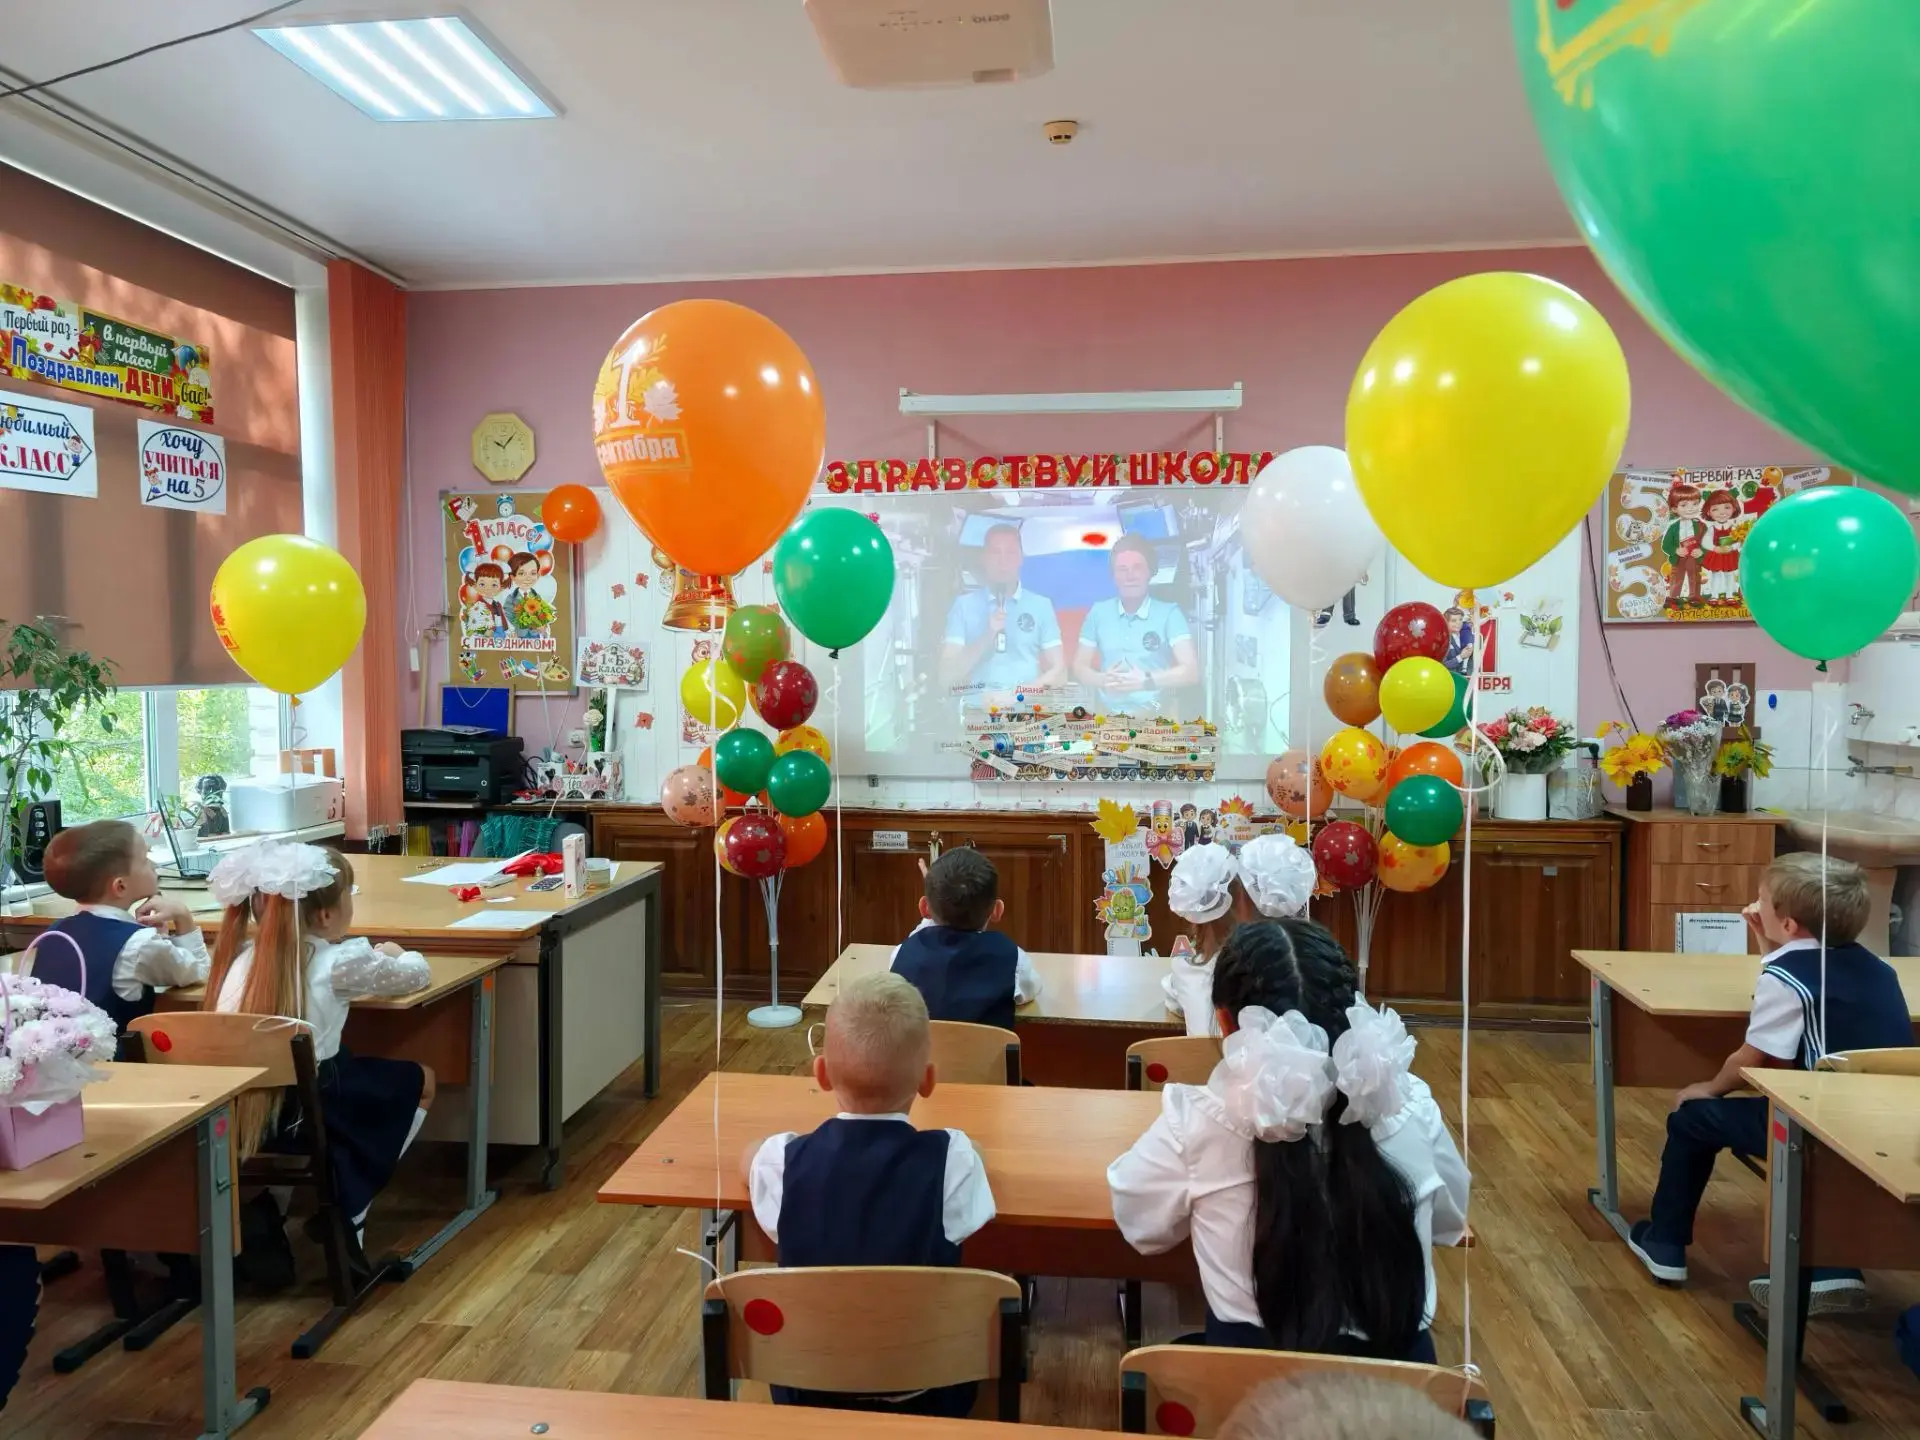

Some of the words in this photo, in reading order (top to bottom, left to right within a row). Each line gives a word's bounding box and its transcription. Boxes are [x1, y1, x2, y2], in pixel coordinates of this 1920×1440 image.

[4, 310, 50, 335] Первый
[52, 322, 71, 340] раз
[102, 324, 115, 340] в
[115, 334, 169, 358] первый
[11, 335, 123, 393] Поздравляем,
[125, 366, 175, 400] ДЕТИ
[114, 349, 158, 371] класс!
[610, 340, 641, 429] 1
[0, 413, 71, 440] юбимый
[144, 449, 220, 480] УЧИТЬСЯ
[826, 452, 1122, 494] ЗДРАВСТВУЙ
[1684, 466, 1734, 484] ПЕРВЫЙ
[1737, 468, 1763, 481] РАЗ
[167, 478, 190, 495] на
[193, 478, 206, 498] 5
[465, 520, 488, 557] 1
[483, 521, 543, 543] КЛАСС!
[462, 638, 471, 649] С
[474, 637, 555, 650] ПРАЗДНИКОМ!
[598, 665, 627, 673] КЛАСС
[601, 653, 607, 664] 1
[1015, 685, 1045, 694] Диана
[1015, 734, 1043, 743] Кирил
